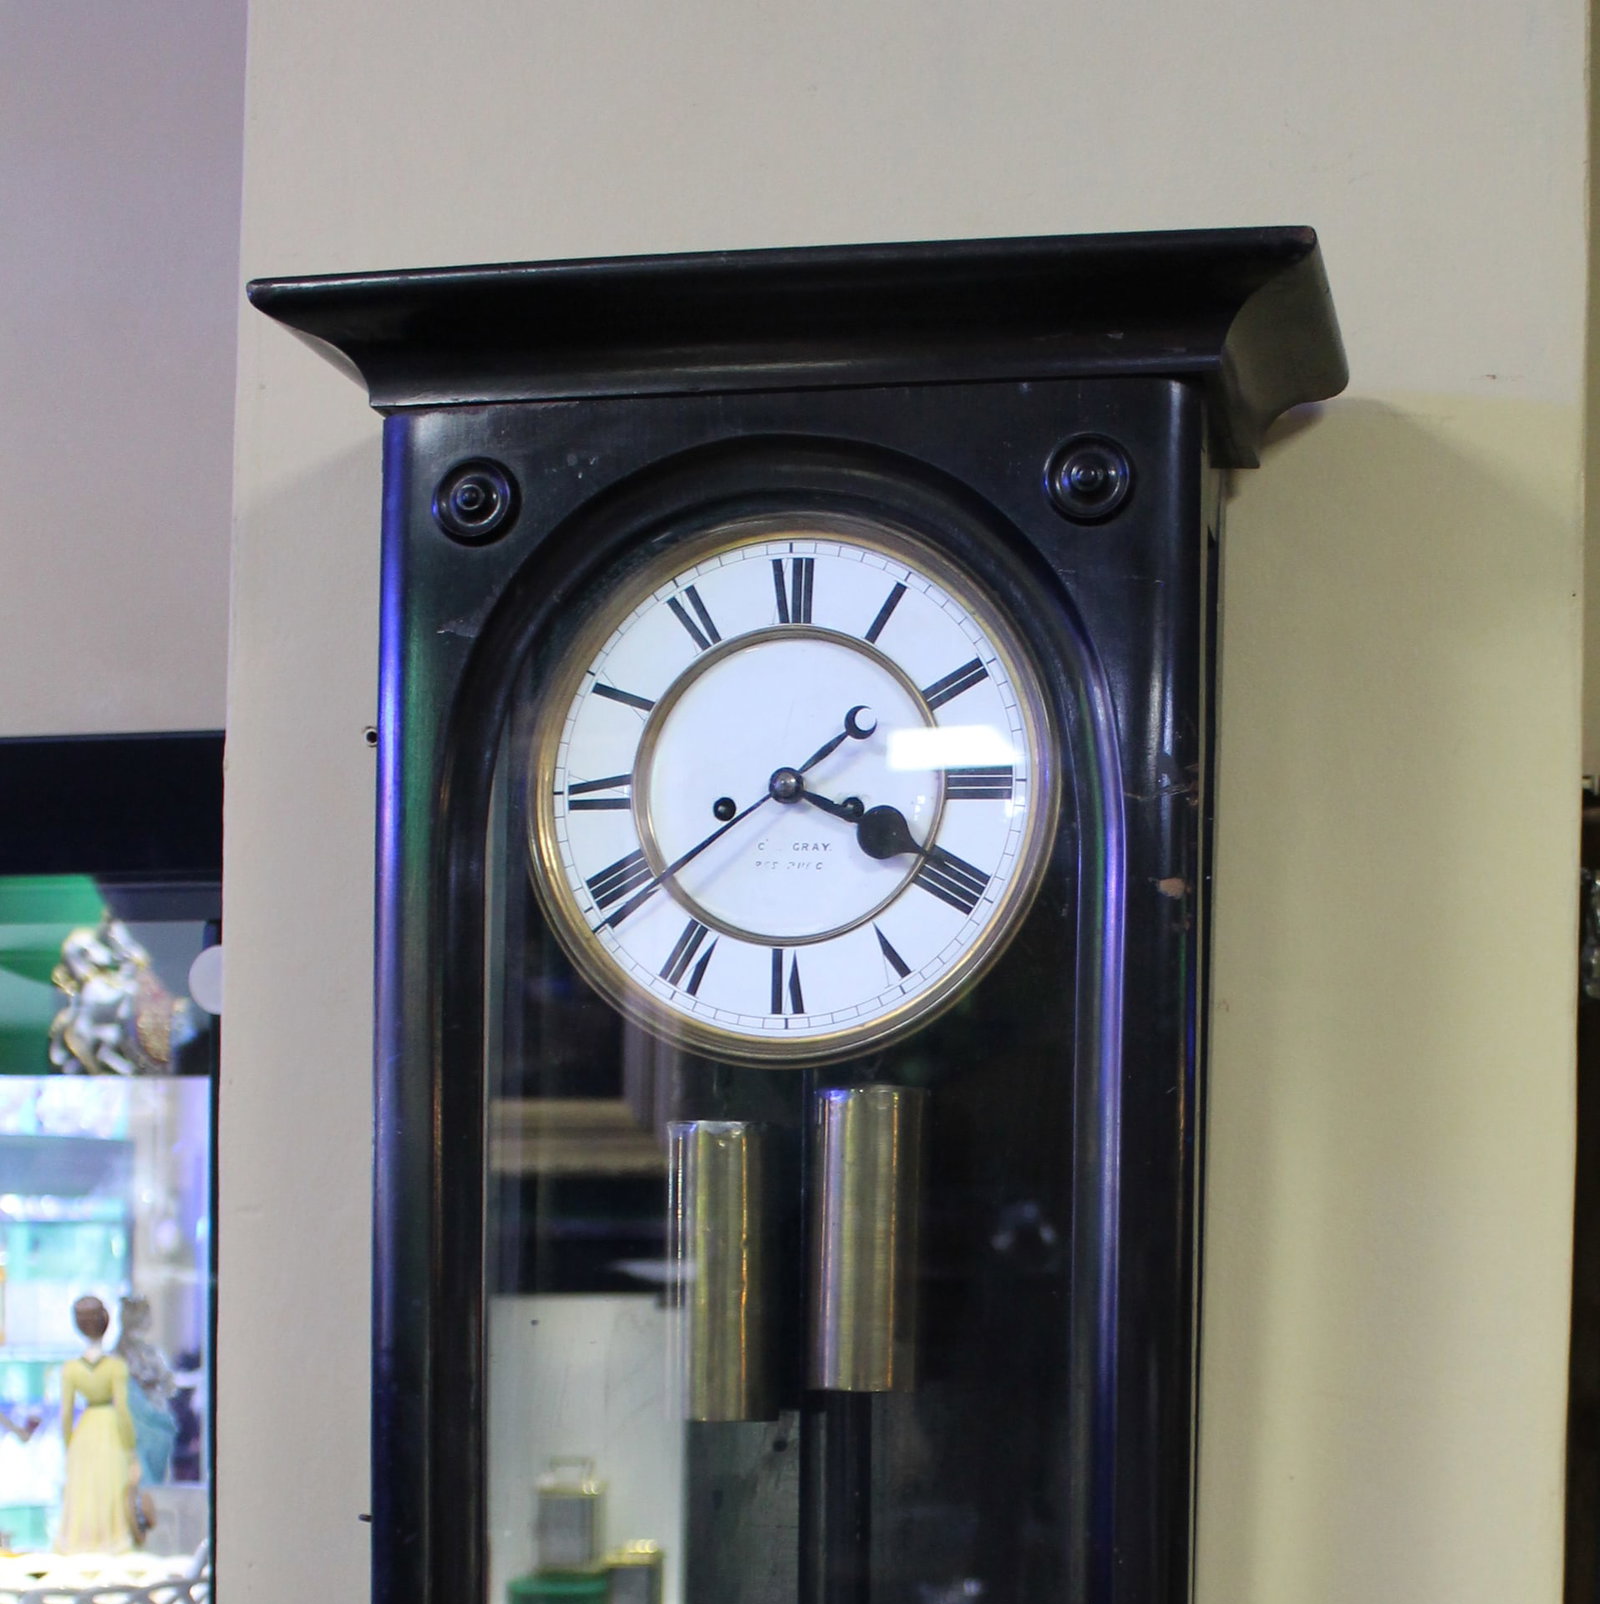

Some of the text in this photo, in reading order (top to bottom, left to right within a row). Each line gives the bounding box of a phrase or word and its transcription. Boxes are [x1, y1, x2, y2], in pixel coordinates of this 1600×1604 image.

[772, 557, 814, 625] XII
[864, 580, 908, 643] I
[921, 656, 990, 711] II
[946, 765, 1014, 800] III
[913, 844, 992, 917] IIII
